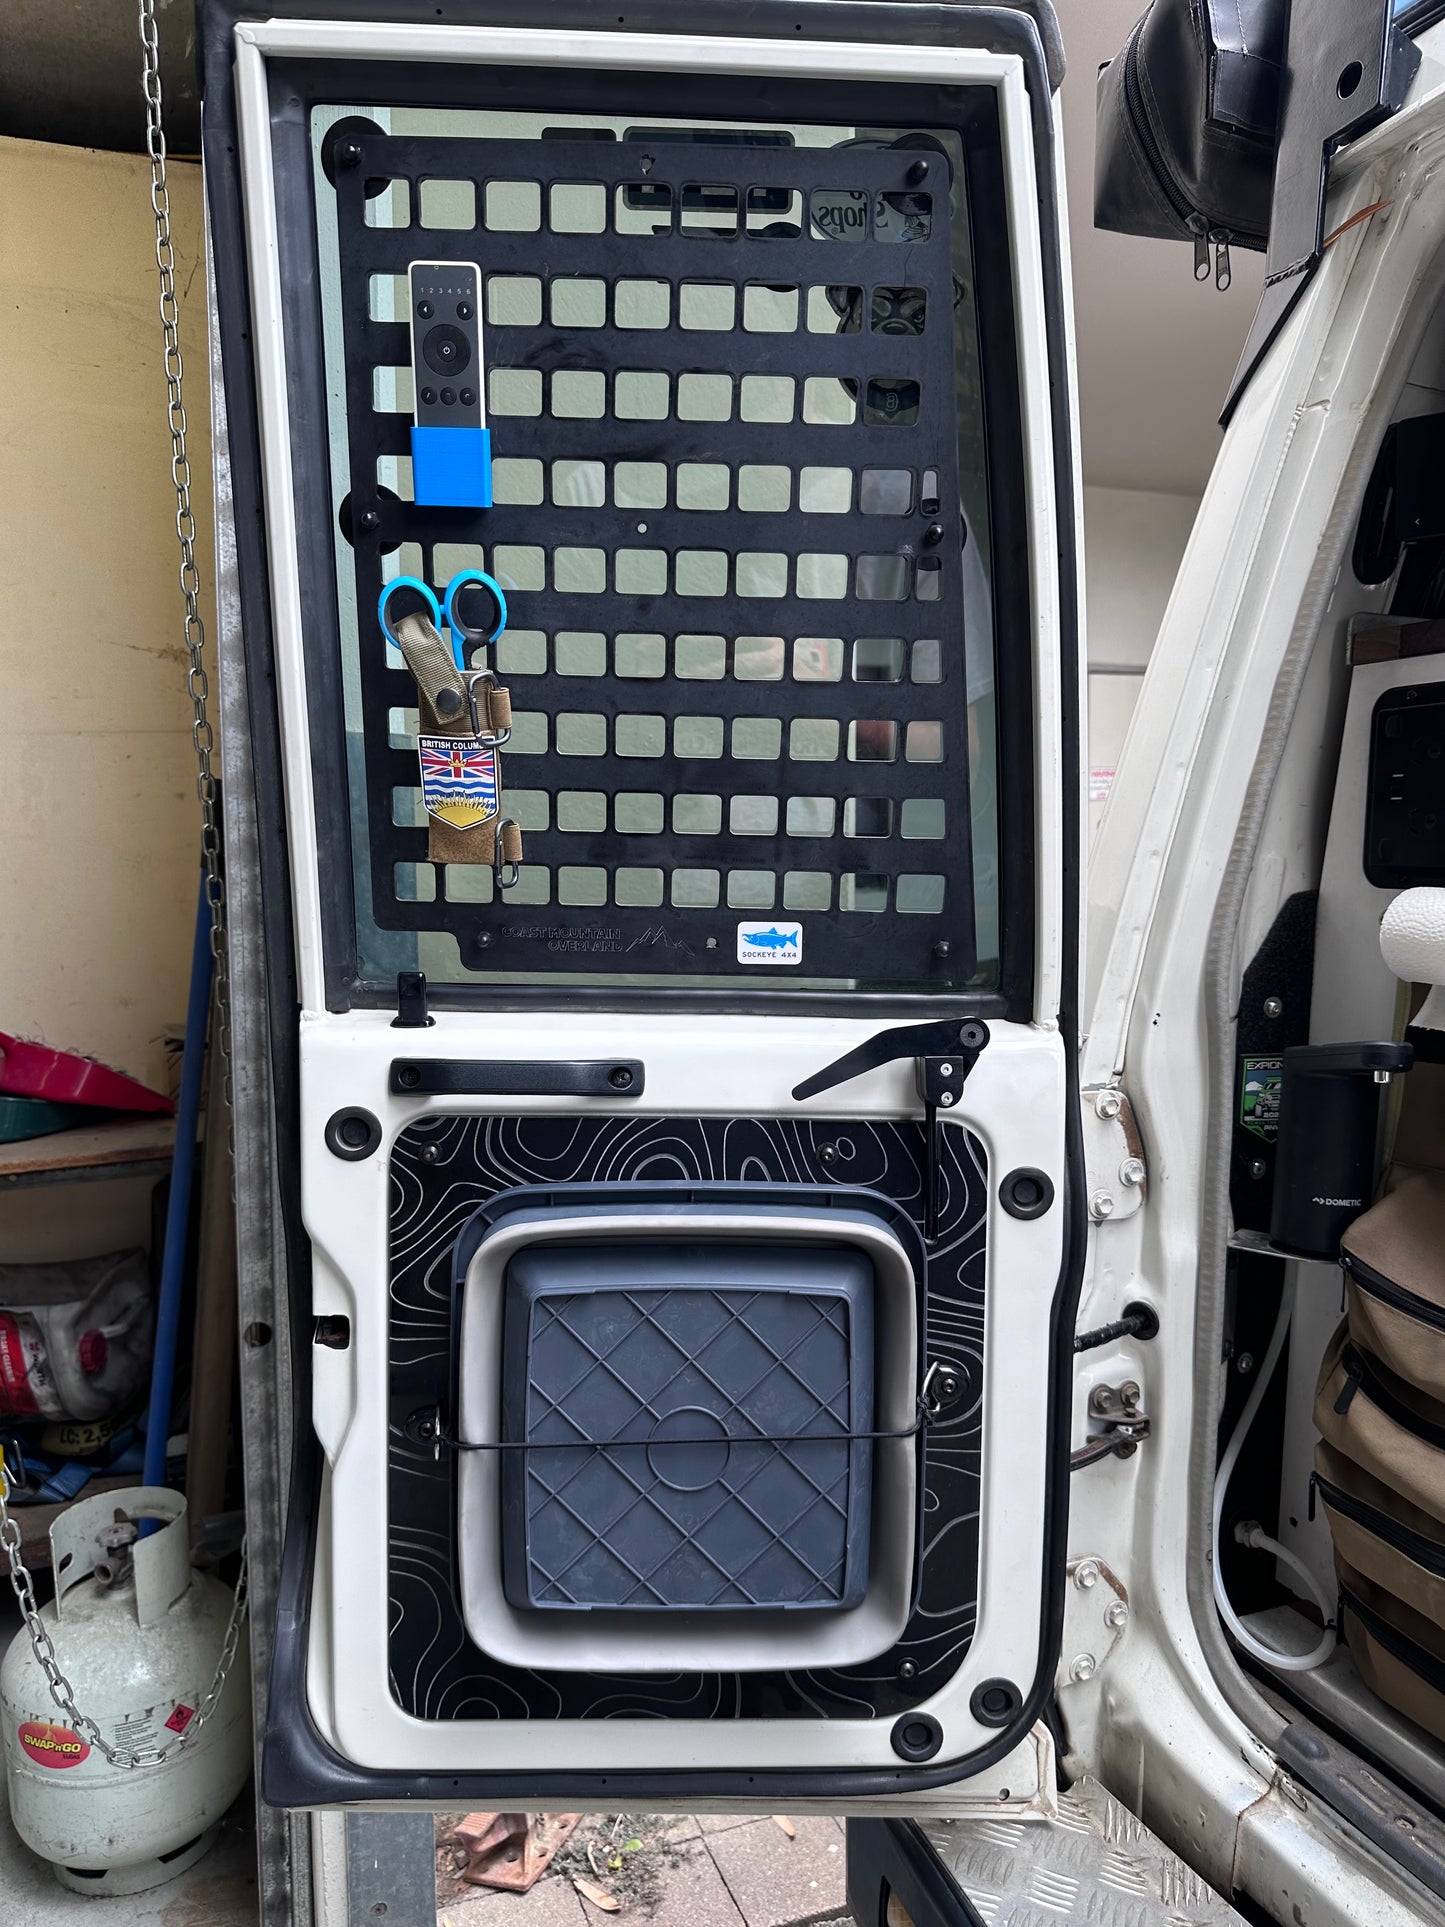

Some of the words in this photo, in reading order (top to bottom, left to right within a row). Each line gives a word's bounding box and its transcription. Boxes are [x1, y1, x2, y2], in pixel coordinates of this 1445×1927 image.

[421, 740, 451, 749] BRITISH
[501, 927, 546, 937] COAST
[548, 928, 621, 939] MOUNTAIN
[548, 941, 622, 951] OVERLAND
[1325, 1198, 1362, 1206] DOMETIC
[60, 1428, 80, 1445] LC:
